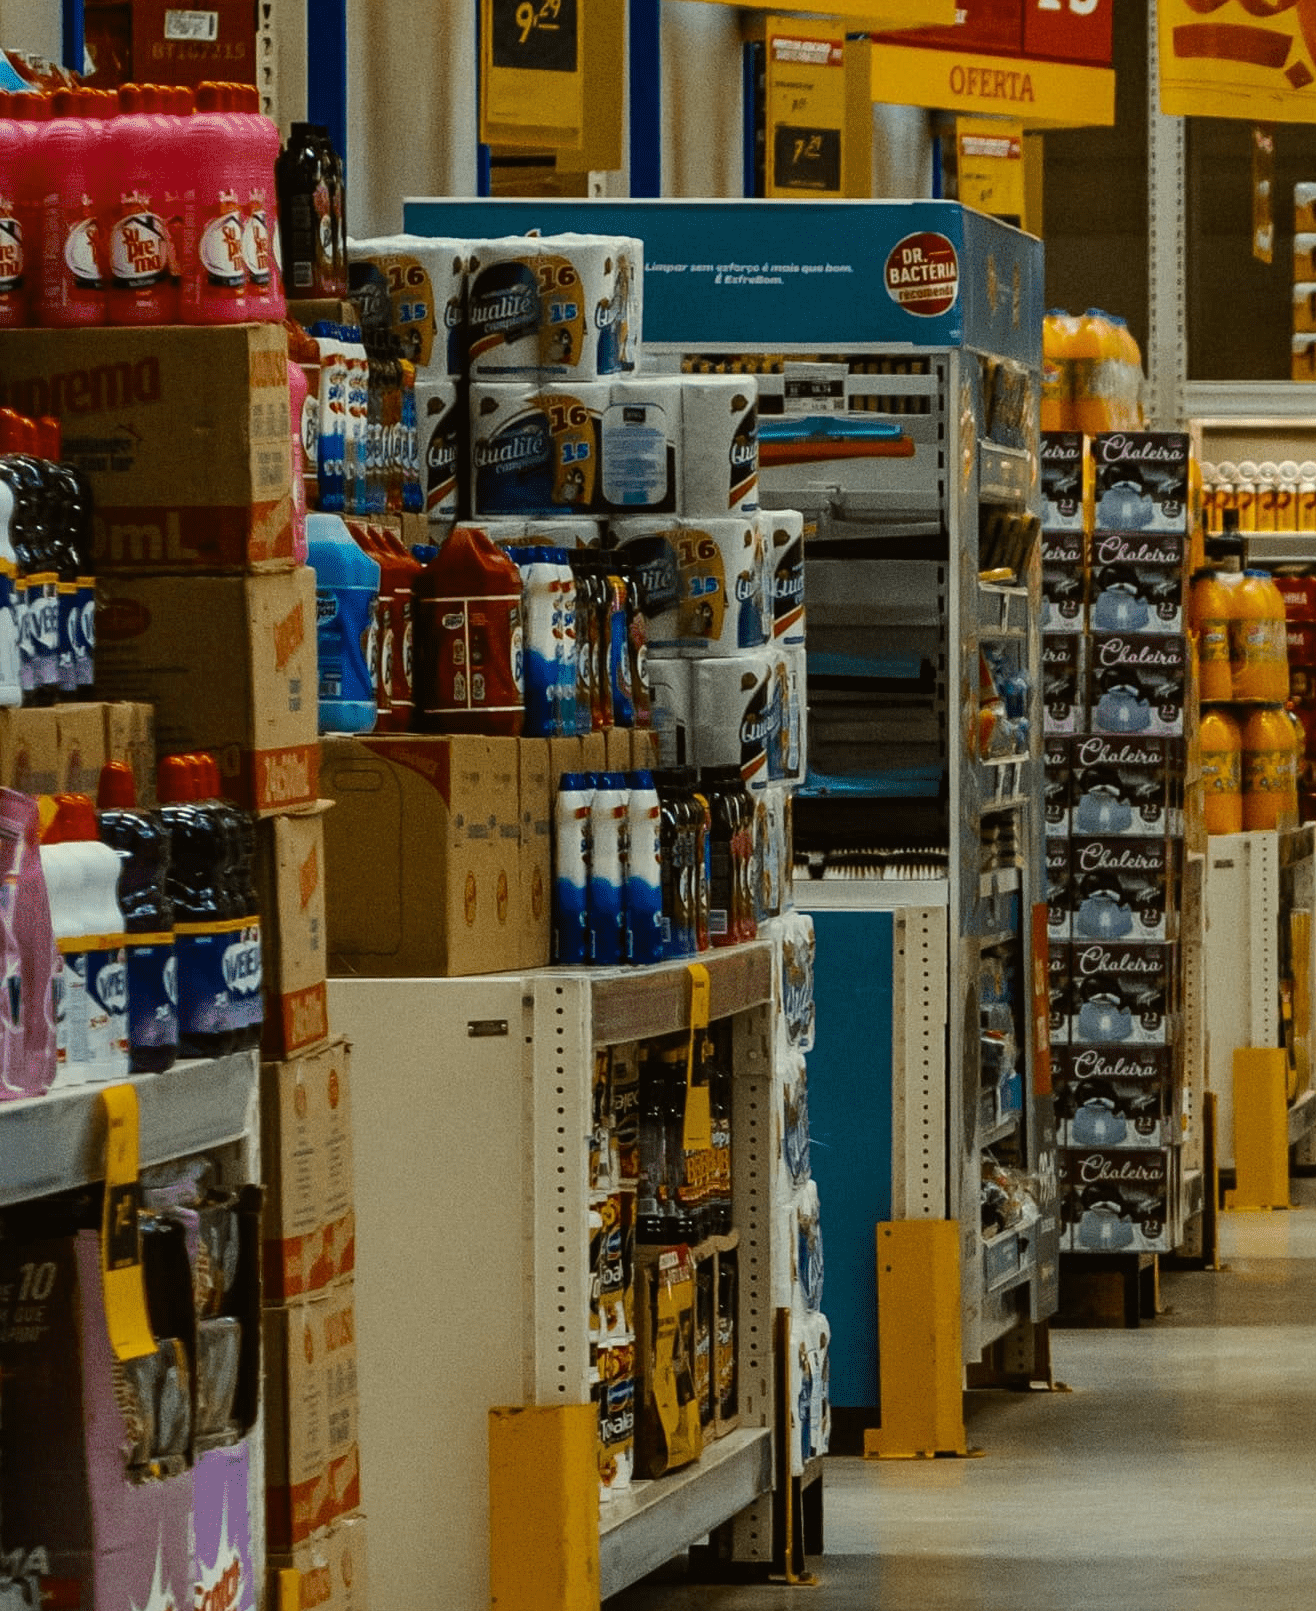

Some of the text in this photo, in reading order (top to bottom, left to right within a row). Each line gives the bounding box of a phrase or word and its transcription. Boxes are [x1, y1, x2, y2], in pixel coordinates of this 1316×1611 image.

[950, 65, 1035, 102] OFERTA
[645, 263, 688, 273] Limpar
[902, 247, 927, 264] DR.
[890, 261, 957, 284] BACTÉRIA
[550, 405, 588, 431] 16
[1101, 434, 1184, 462] Chaleira
[1096, 536, 1179, 563] Chaleira
[1099, 639, 1181, 667] Chaleira
[1077, 738, 1161, 767] Chaleira
[1077, 946, 1162, 974] Chaleira
[1079, 1154, 1163, 1182] Chaleira
